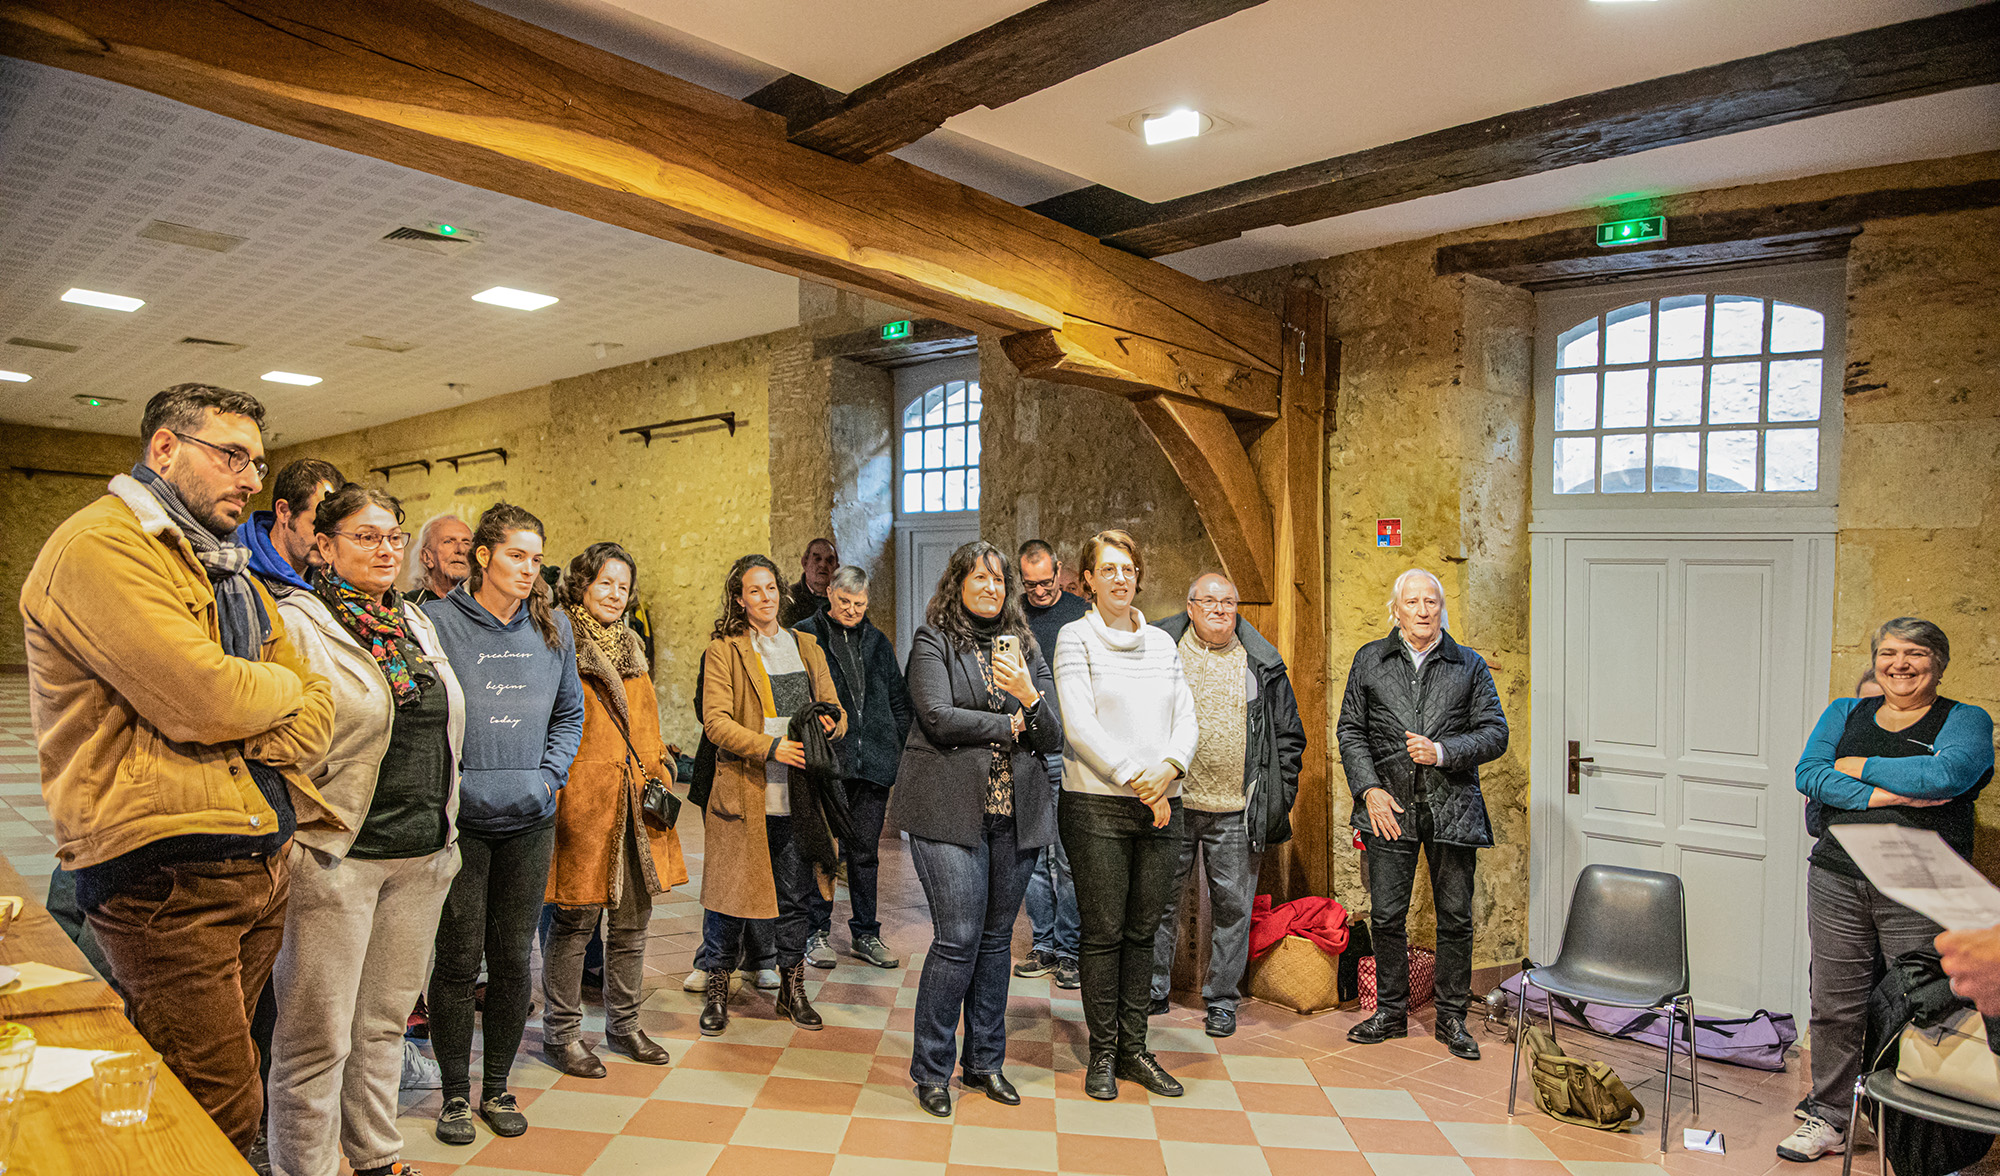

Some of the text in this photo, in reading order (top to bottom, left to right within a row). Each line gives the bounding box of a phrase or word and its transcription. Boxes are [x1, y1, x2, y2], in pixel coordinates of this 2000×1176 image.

[476, 649, 534, 665] greatness
[485, 680, 527, 696] begins
[489, 714, 522, 729] today
